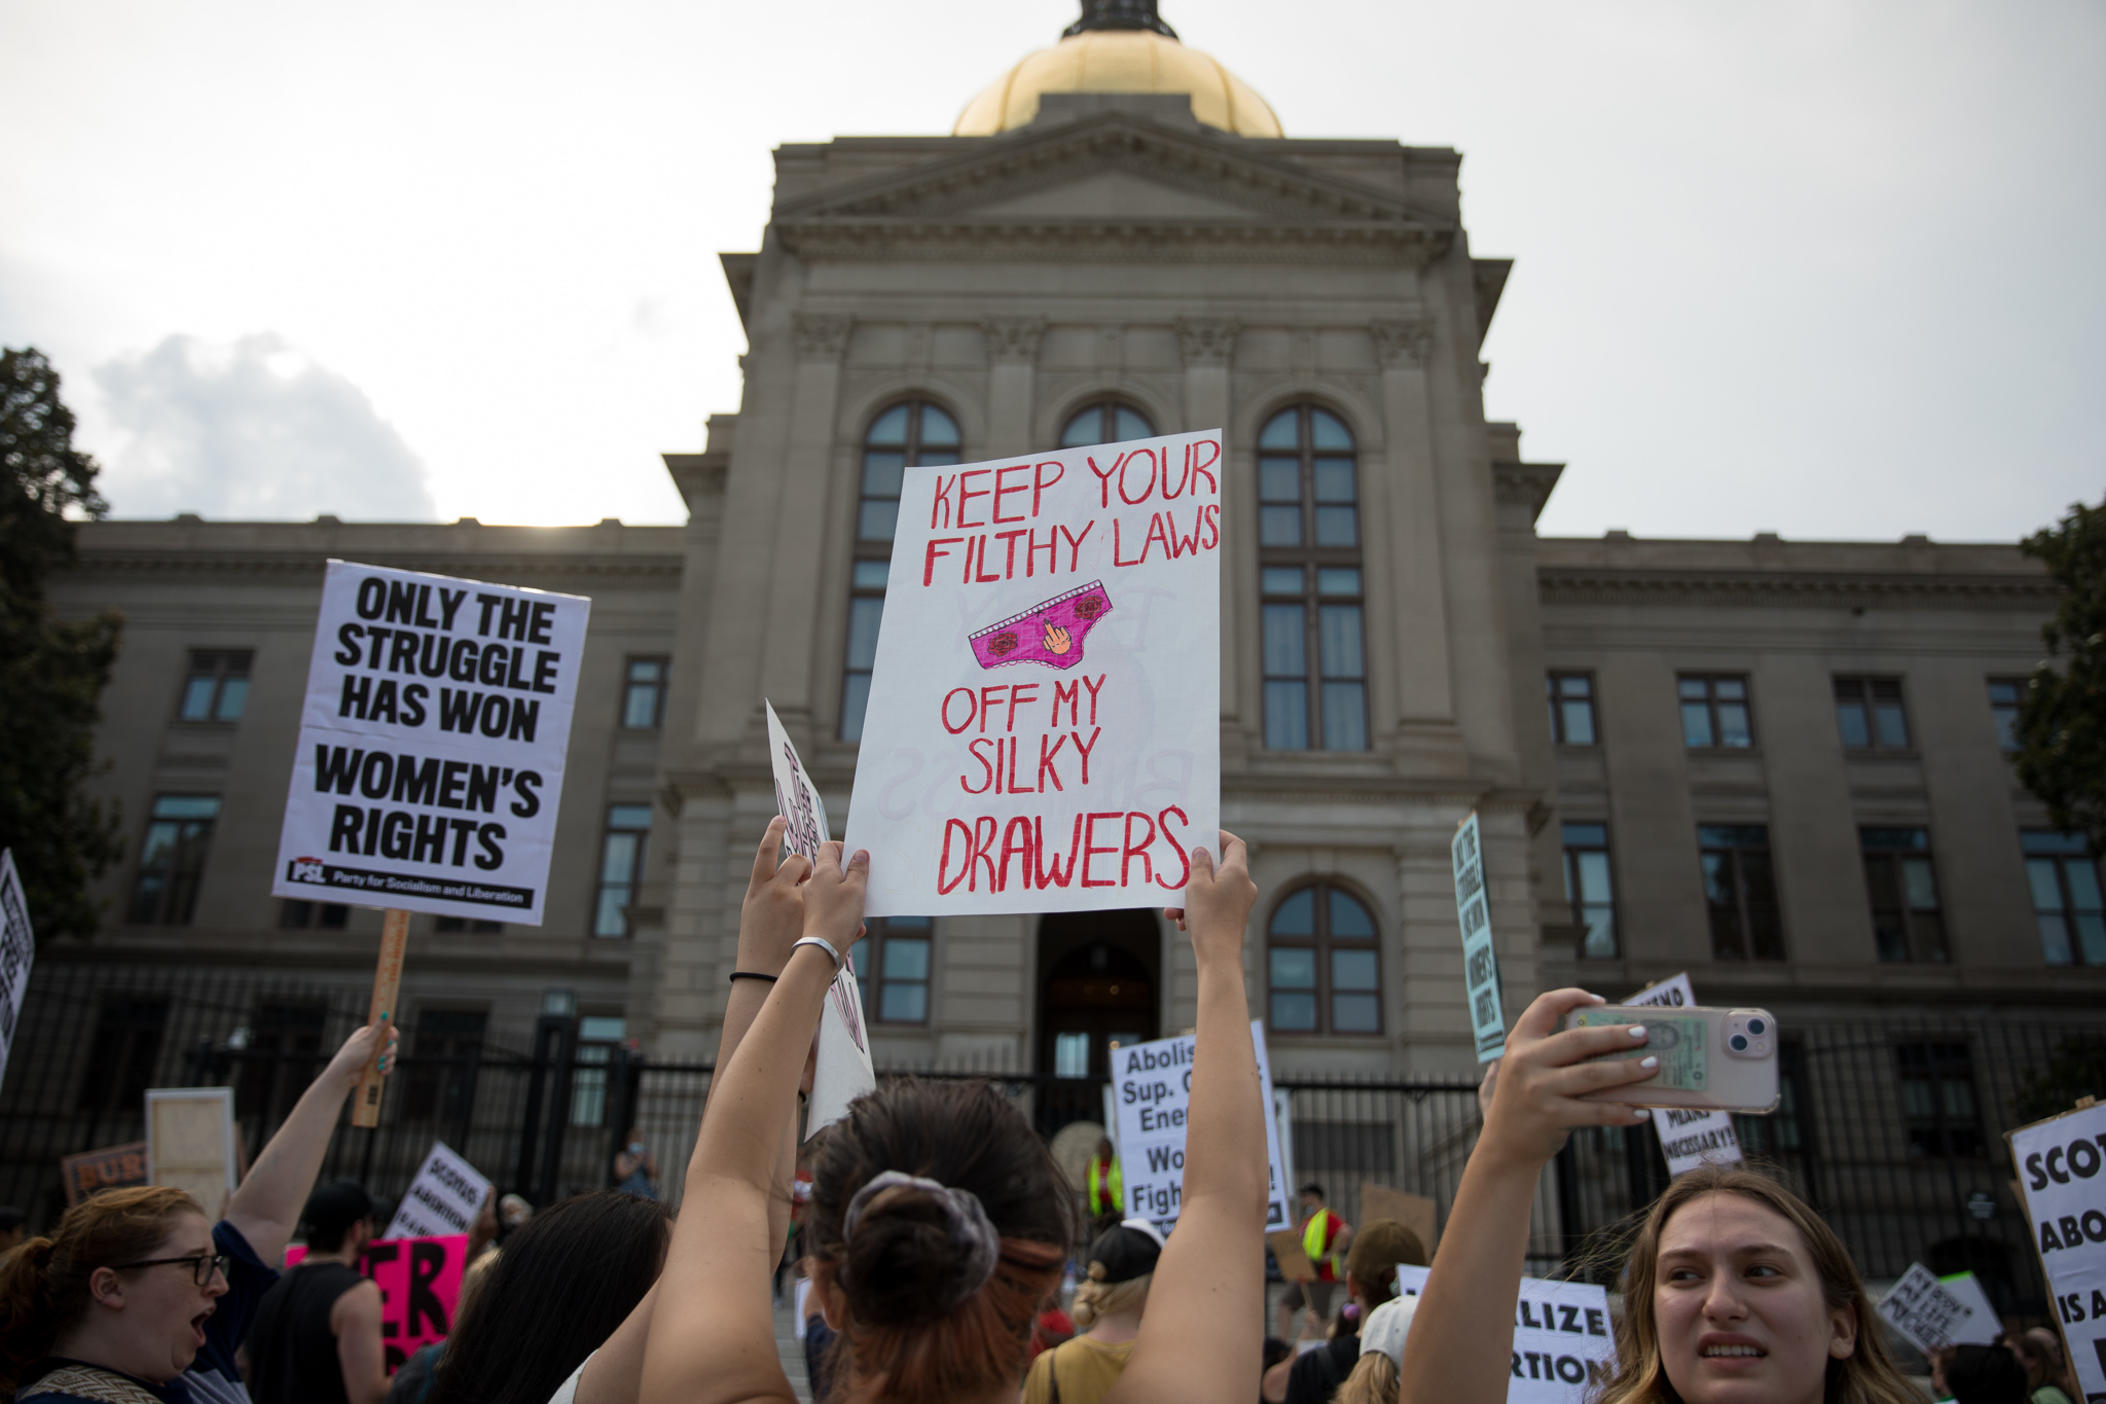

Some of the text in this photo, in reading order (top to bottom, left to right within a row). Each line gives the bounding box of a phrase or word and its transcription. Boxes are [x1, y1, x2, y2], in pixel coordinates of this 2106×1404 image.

[931, 440, 1221, 529] KEEP YOUR
[924, 504, 1219, 587] FILTHY LAWS
[356, 577, 556, 646] ONLY THE
[334, 622, 561, 694] STRUGGLE
[338, 674, 540, 743] HAS WON
[942, 674, 1106, 734] OFF MY
[315, 743, 543, 819] WOMEN'S
[961, 727, 1101, 794] SILKY
[328, 803, 507, 871] RIGHTS
[938, 805, 1189, 895] DRAWERS
[292, 862, 524, 904] PSL Party for Socialism and Liberation
[1127, 1042, 1194, 1075] Abolis
[1123, 1078, 1174, 1105] Sup.
[1140, 1107, 1188, 1132] Ene
[1147, 1145, 1184, 1173] Wo
[1132, 1180, 1181, 1216] Figh
[1516, 1300, 1607, 1337] LIZE
[2058, 1293, 2086, 1323] IS
